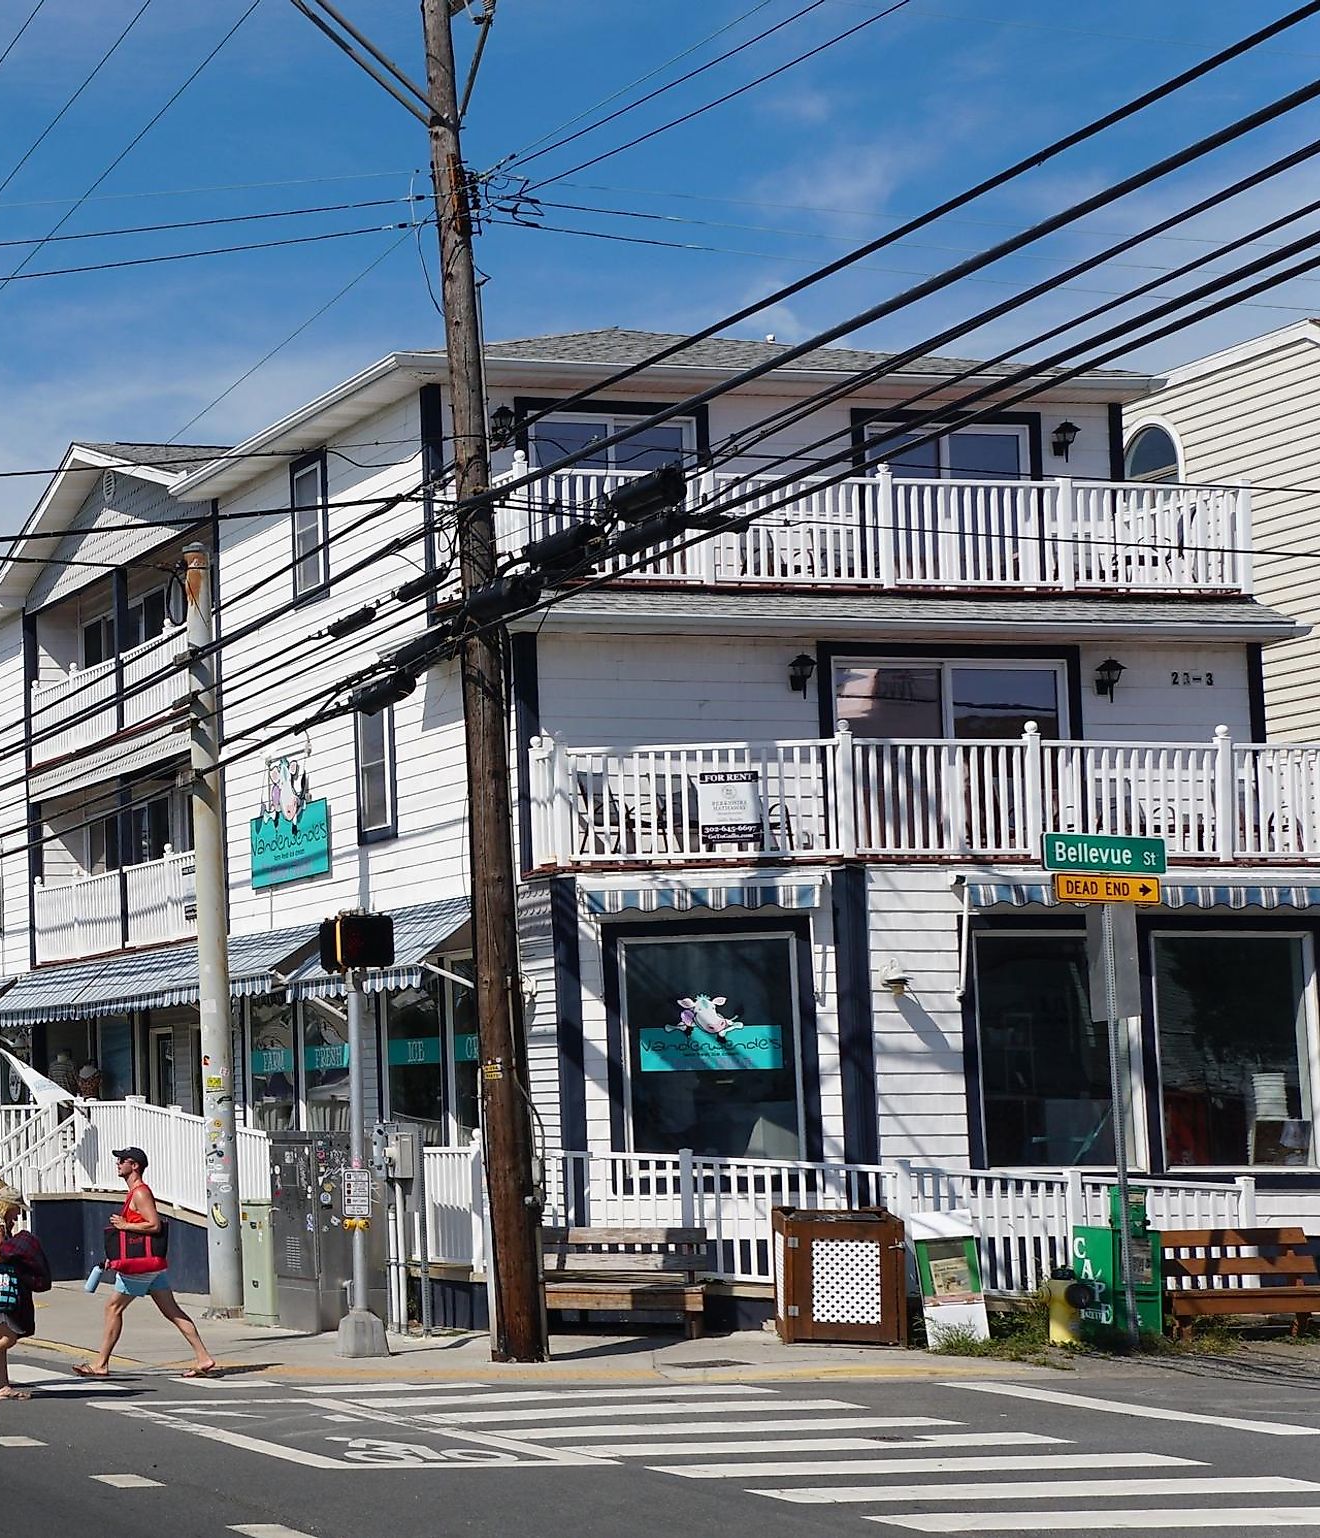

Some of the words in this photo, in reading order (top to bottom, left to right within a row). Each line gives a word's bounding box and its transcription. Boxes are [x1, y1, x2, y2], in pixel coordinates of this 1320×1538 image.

[704, 774, 723, 782] FOR
[727, 773, 753, 781] RENT
[1054, 841, 1133, 865] Bellevue
[1143, 851, 1156, 866] St
[1066, 880, 1098, 895] DEAD
[1106, 882, 1130, 896] END
[314, 1046, 343, 1068] FRESH
[407, 1040, 425, 1062] ICE
